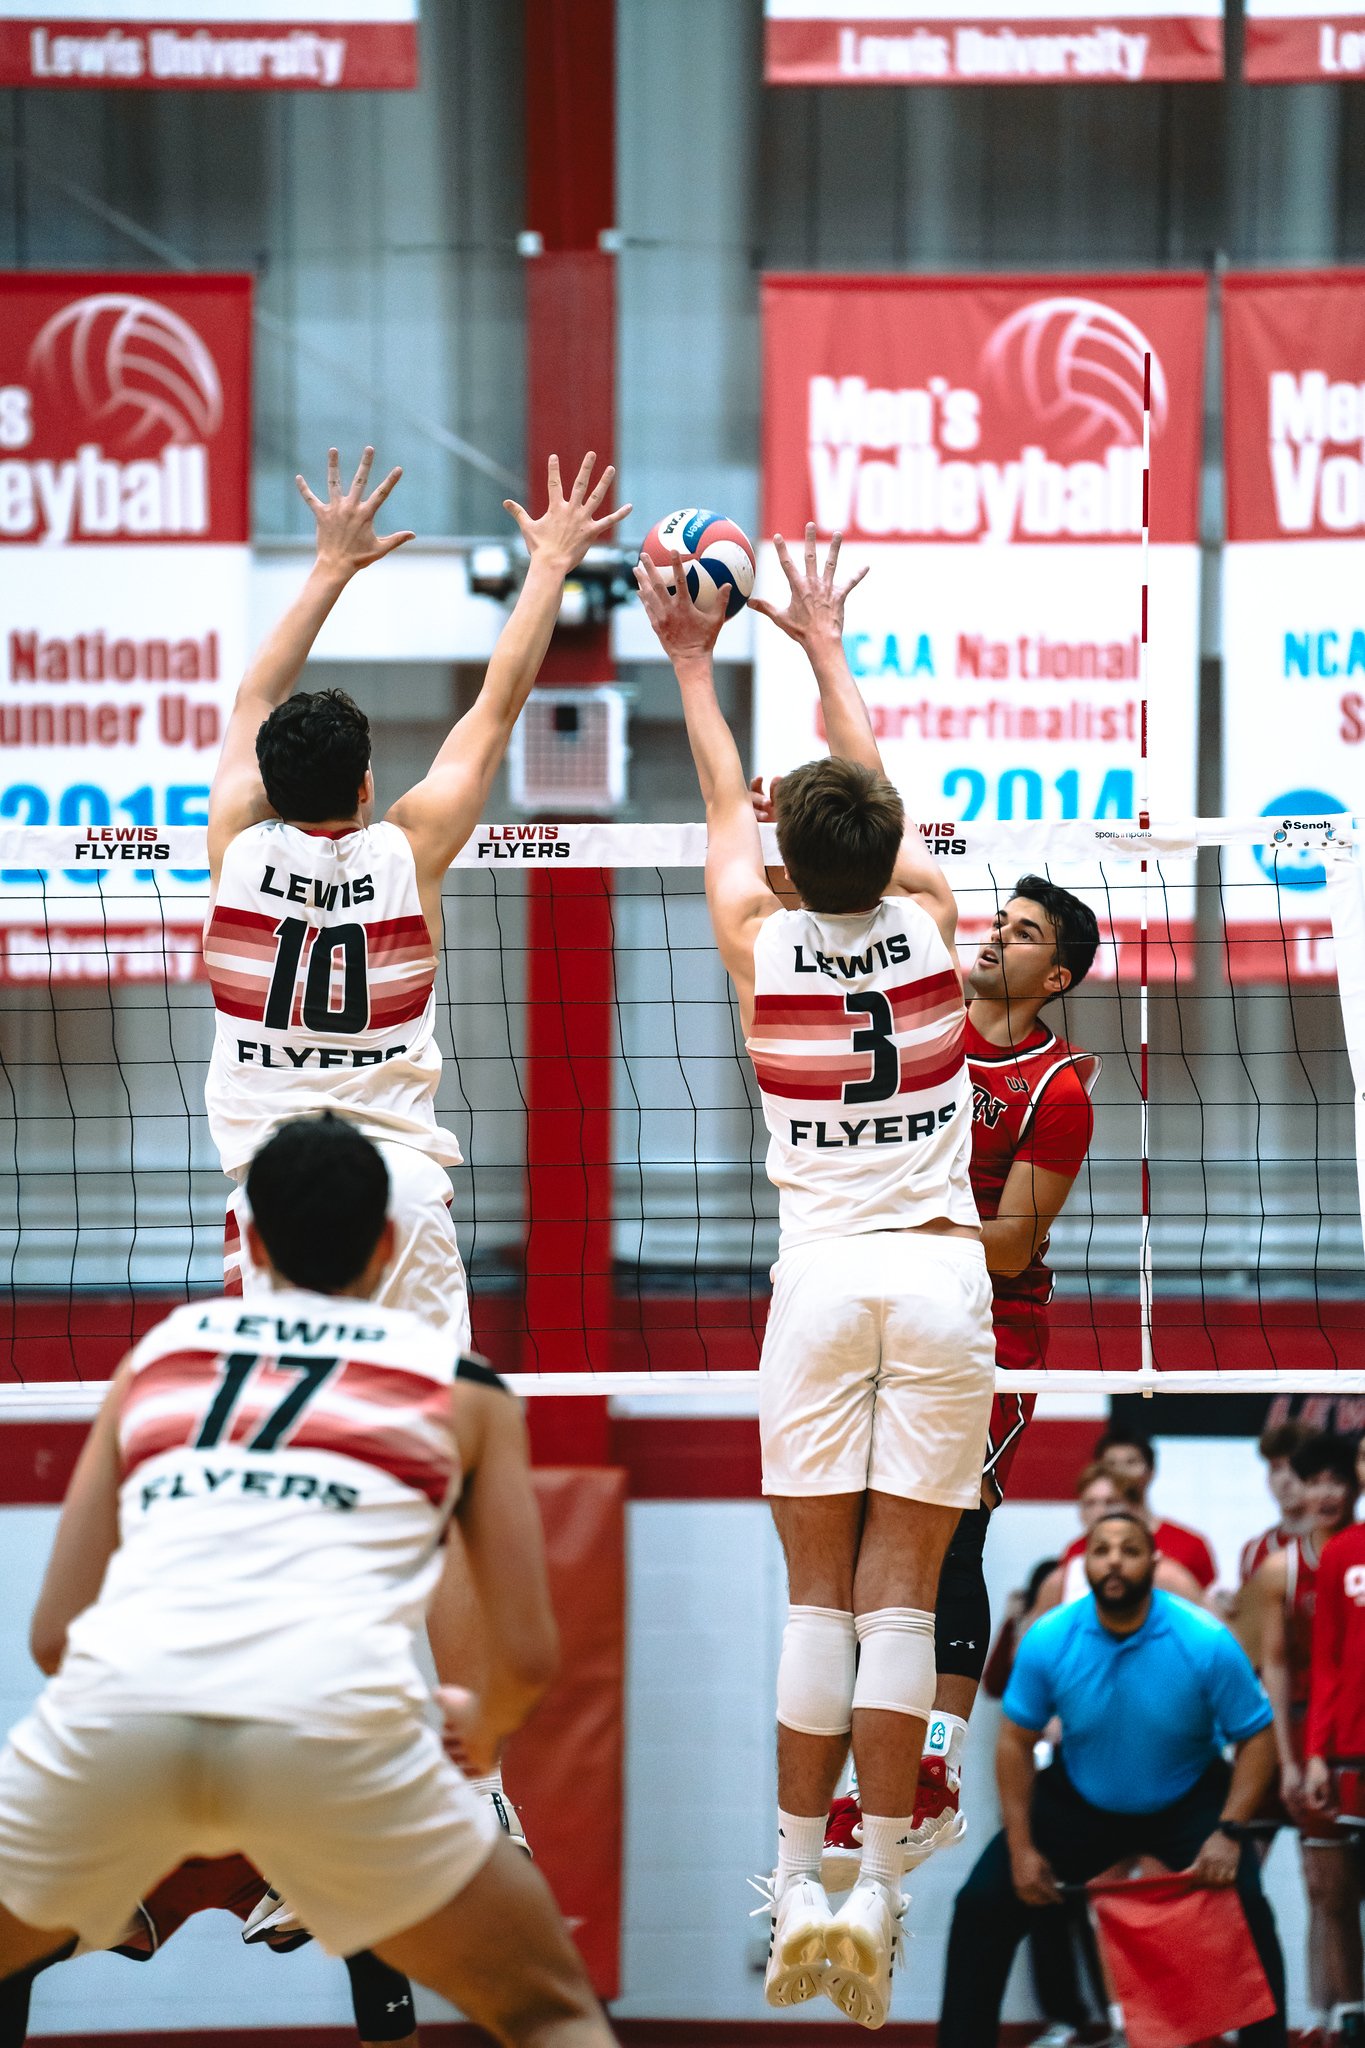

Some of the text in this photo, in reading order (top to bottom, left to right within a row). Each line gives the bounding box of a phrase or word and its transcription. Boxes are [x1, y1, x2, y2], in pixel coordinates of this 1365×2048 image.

[30, 26, 347, 86] Lewis University
[1319, 25, 1365, 71] Le
[1271, 372, 1365, 443] Me
[808, 444, 1146, 545] Volleyball
[9, 629, 217, 683] National
[842, 633, 935, 678] CAA
[955, 631, 1139, 680] National
[158, 694, 219, 751] Up
[814, 699, 1135, 741] arterfinalist
[942, 767, 1135, 820] 2014
[87, 827, 158, 841] LEWIS
[489, 826, 558, 840] LEWIS
[915, 823, 955, 836] WIS
[1293, 821, 1331, 830] Senoh
[75, 844, 170, 860] FLYERS
[478, 843, 570, 858] FLYERS
[259, 865, 375, 911] LEWIS
[264, 916, 371, 1034] 10
[793, 933, 911, 979] LEWIS
[843, 991, 900, 1105] 3
[790, 1101, 957, 1148] FLYERS
[194, 1352, 341, 1452] 17
[140, 1466, 361, 1510] FLYERS
